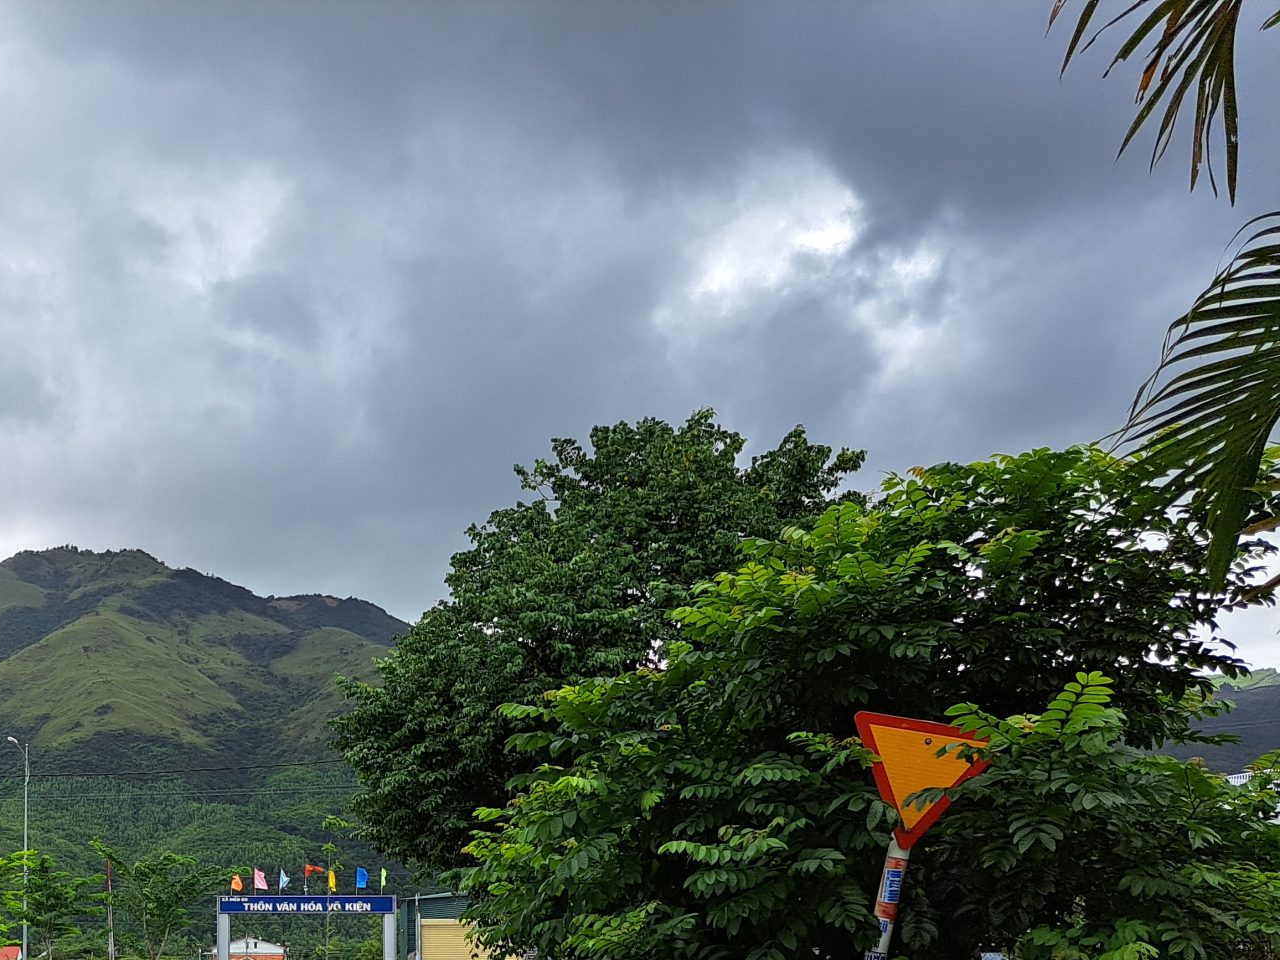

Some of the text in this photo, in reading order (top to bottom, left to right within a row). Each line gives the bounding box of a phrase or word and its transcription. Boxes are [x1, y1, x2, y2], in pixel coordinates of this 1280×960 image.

[243, 902, 273, 912] THÔN
[276, 902, 297, 911] VĂN
[301, 902, 323, 911] HÓA
[345, 901, 371, 913] KIỆN
